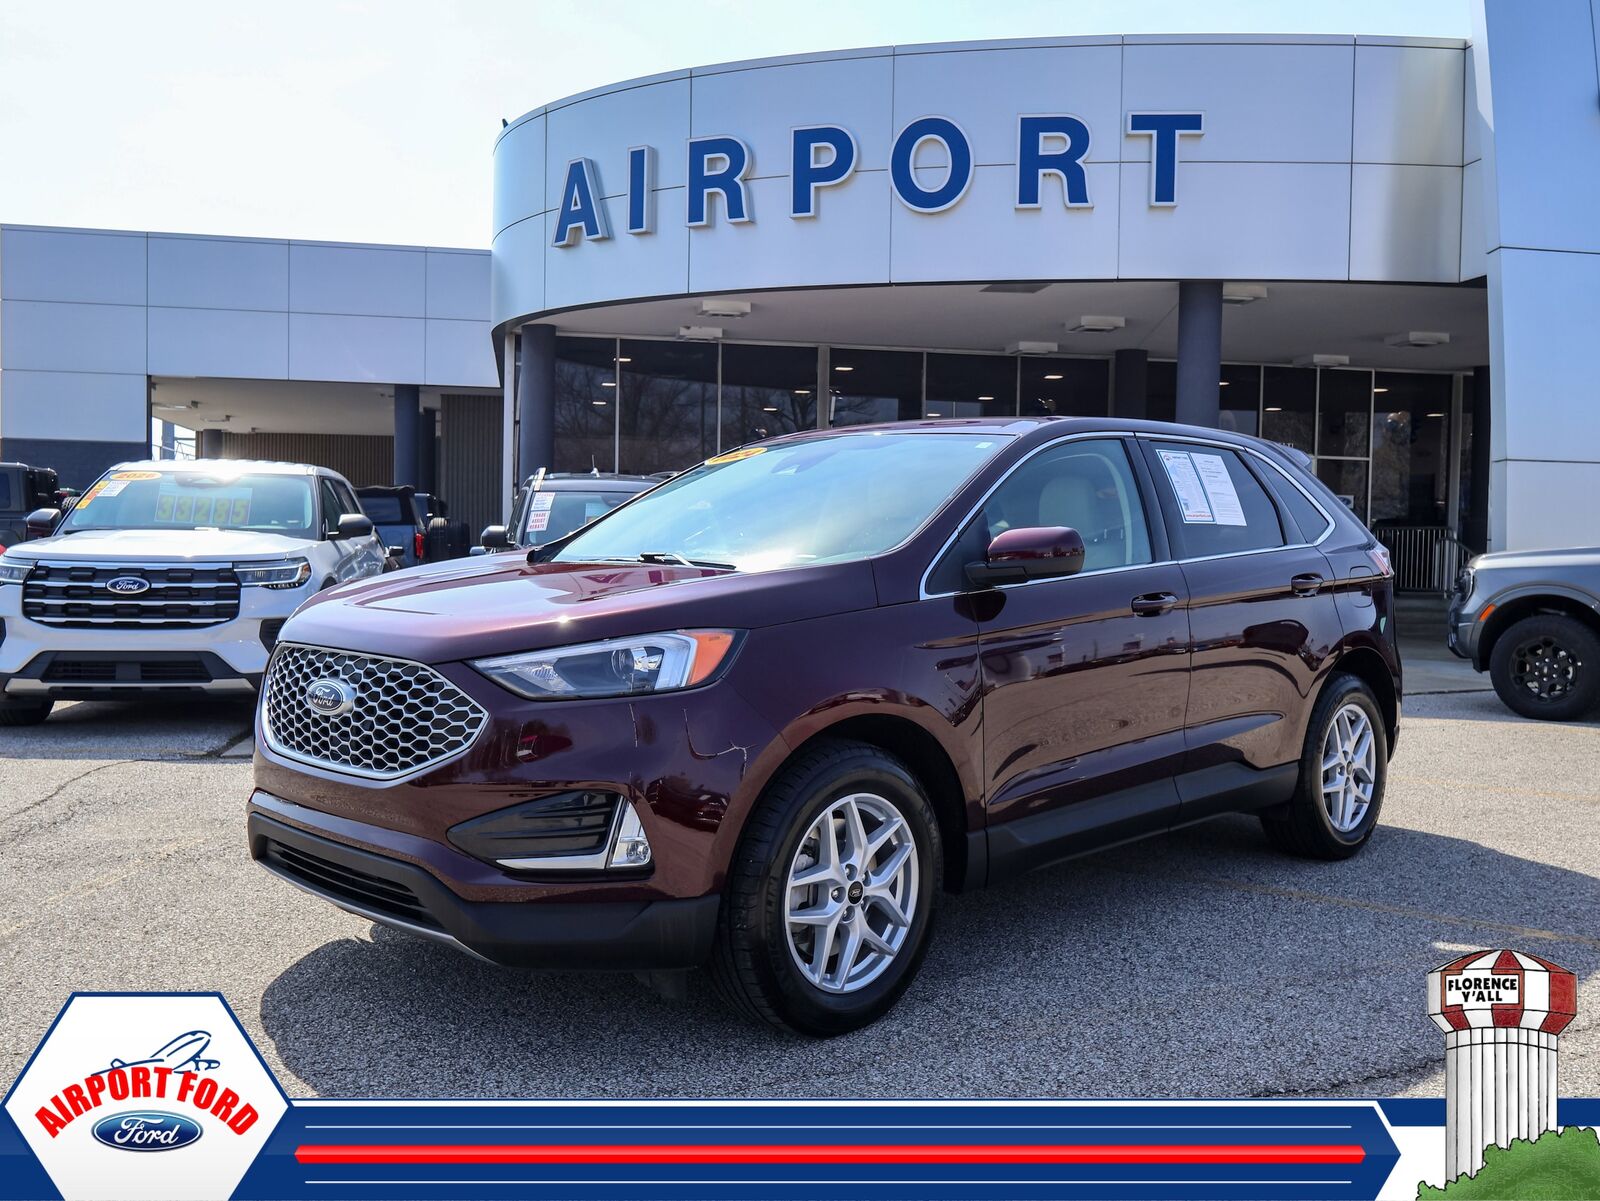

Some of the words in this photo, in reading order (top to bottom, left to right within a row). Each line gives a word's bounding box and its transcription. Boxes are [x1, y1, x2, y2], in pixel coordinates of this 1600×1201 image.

[552, 110, 1205, 248] AIRPORT
[157, 494, 249, 524] 33285
[115, 579, 140, 590] Ford
[312, 687, 335, 706] Ford
